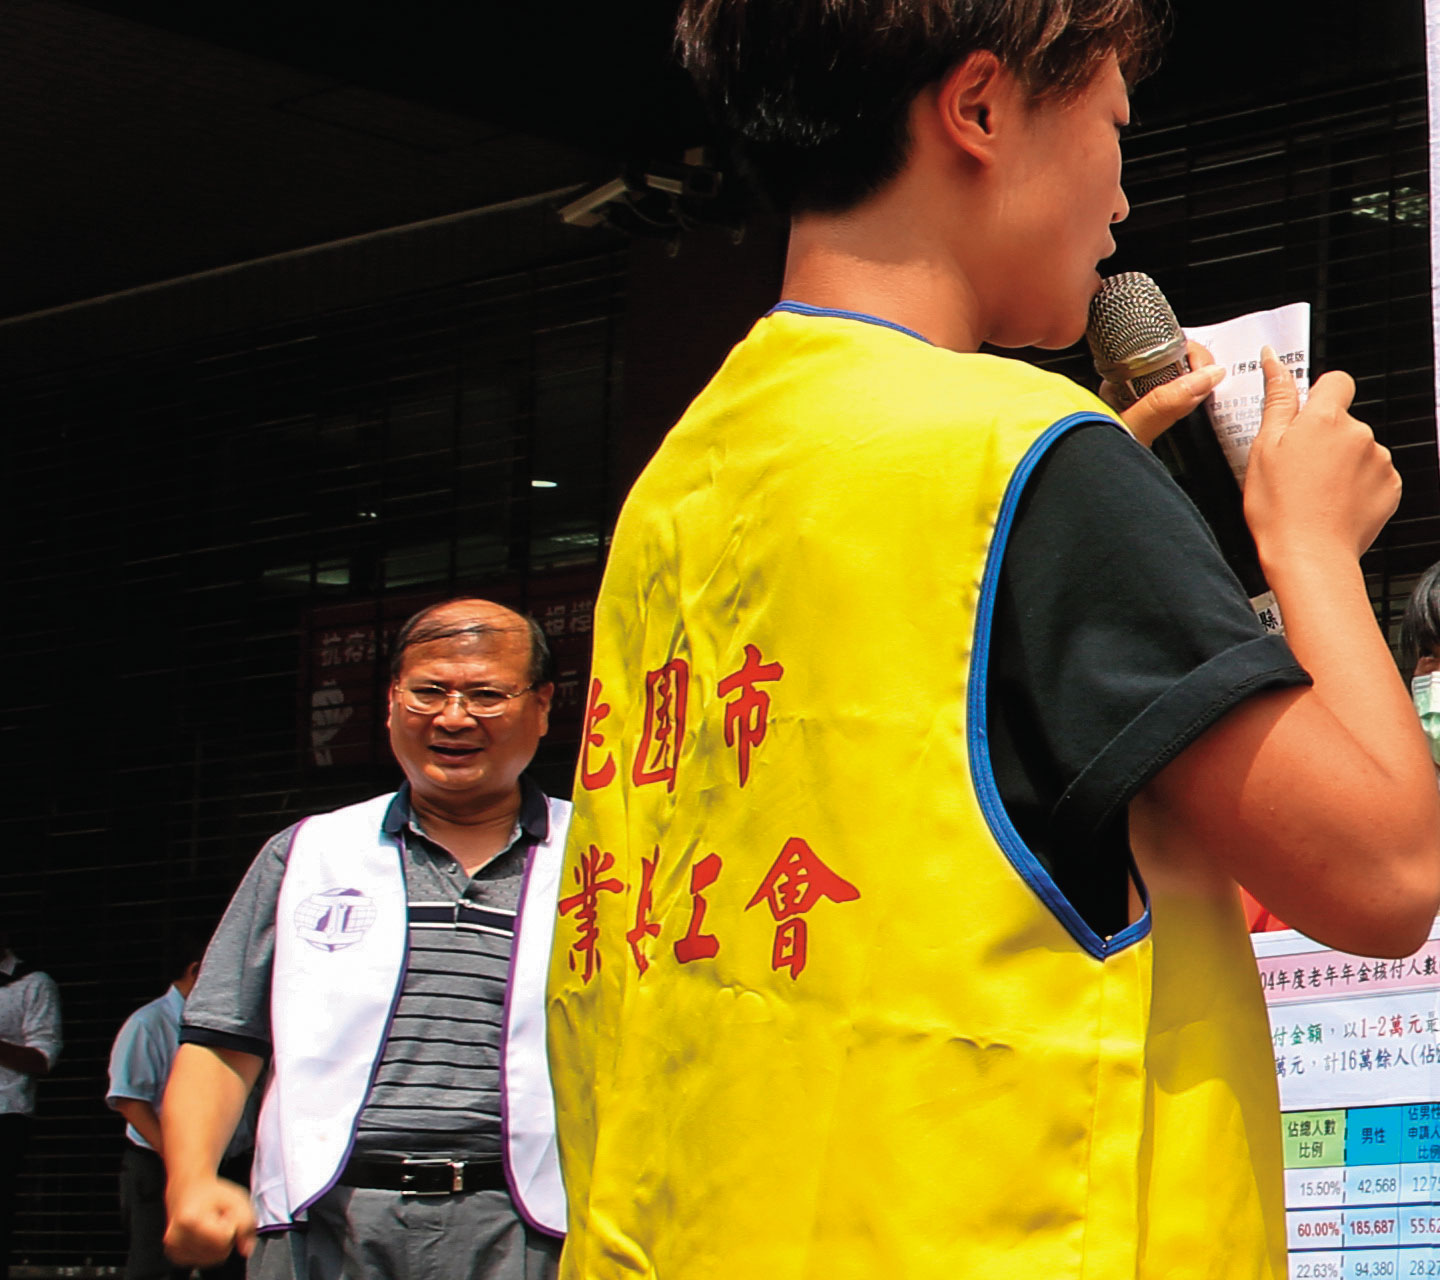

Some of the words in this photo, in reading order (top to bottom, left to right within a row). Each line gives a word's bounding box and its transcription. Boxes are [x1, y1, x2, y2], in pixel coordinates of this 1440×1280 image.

[1300, 1181, 1341, 1197] 15.50%
[1357, 1178, 1397, 1194] 42,568
[1298, 1221, 1340, 1237] 60.00%
[1350, 1219, 1395, 1236] 185,687
[1296, 1263, 1339, 1279] 22.63%
[1355, 1260, 1394, 1277] 94,380
